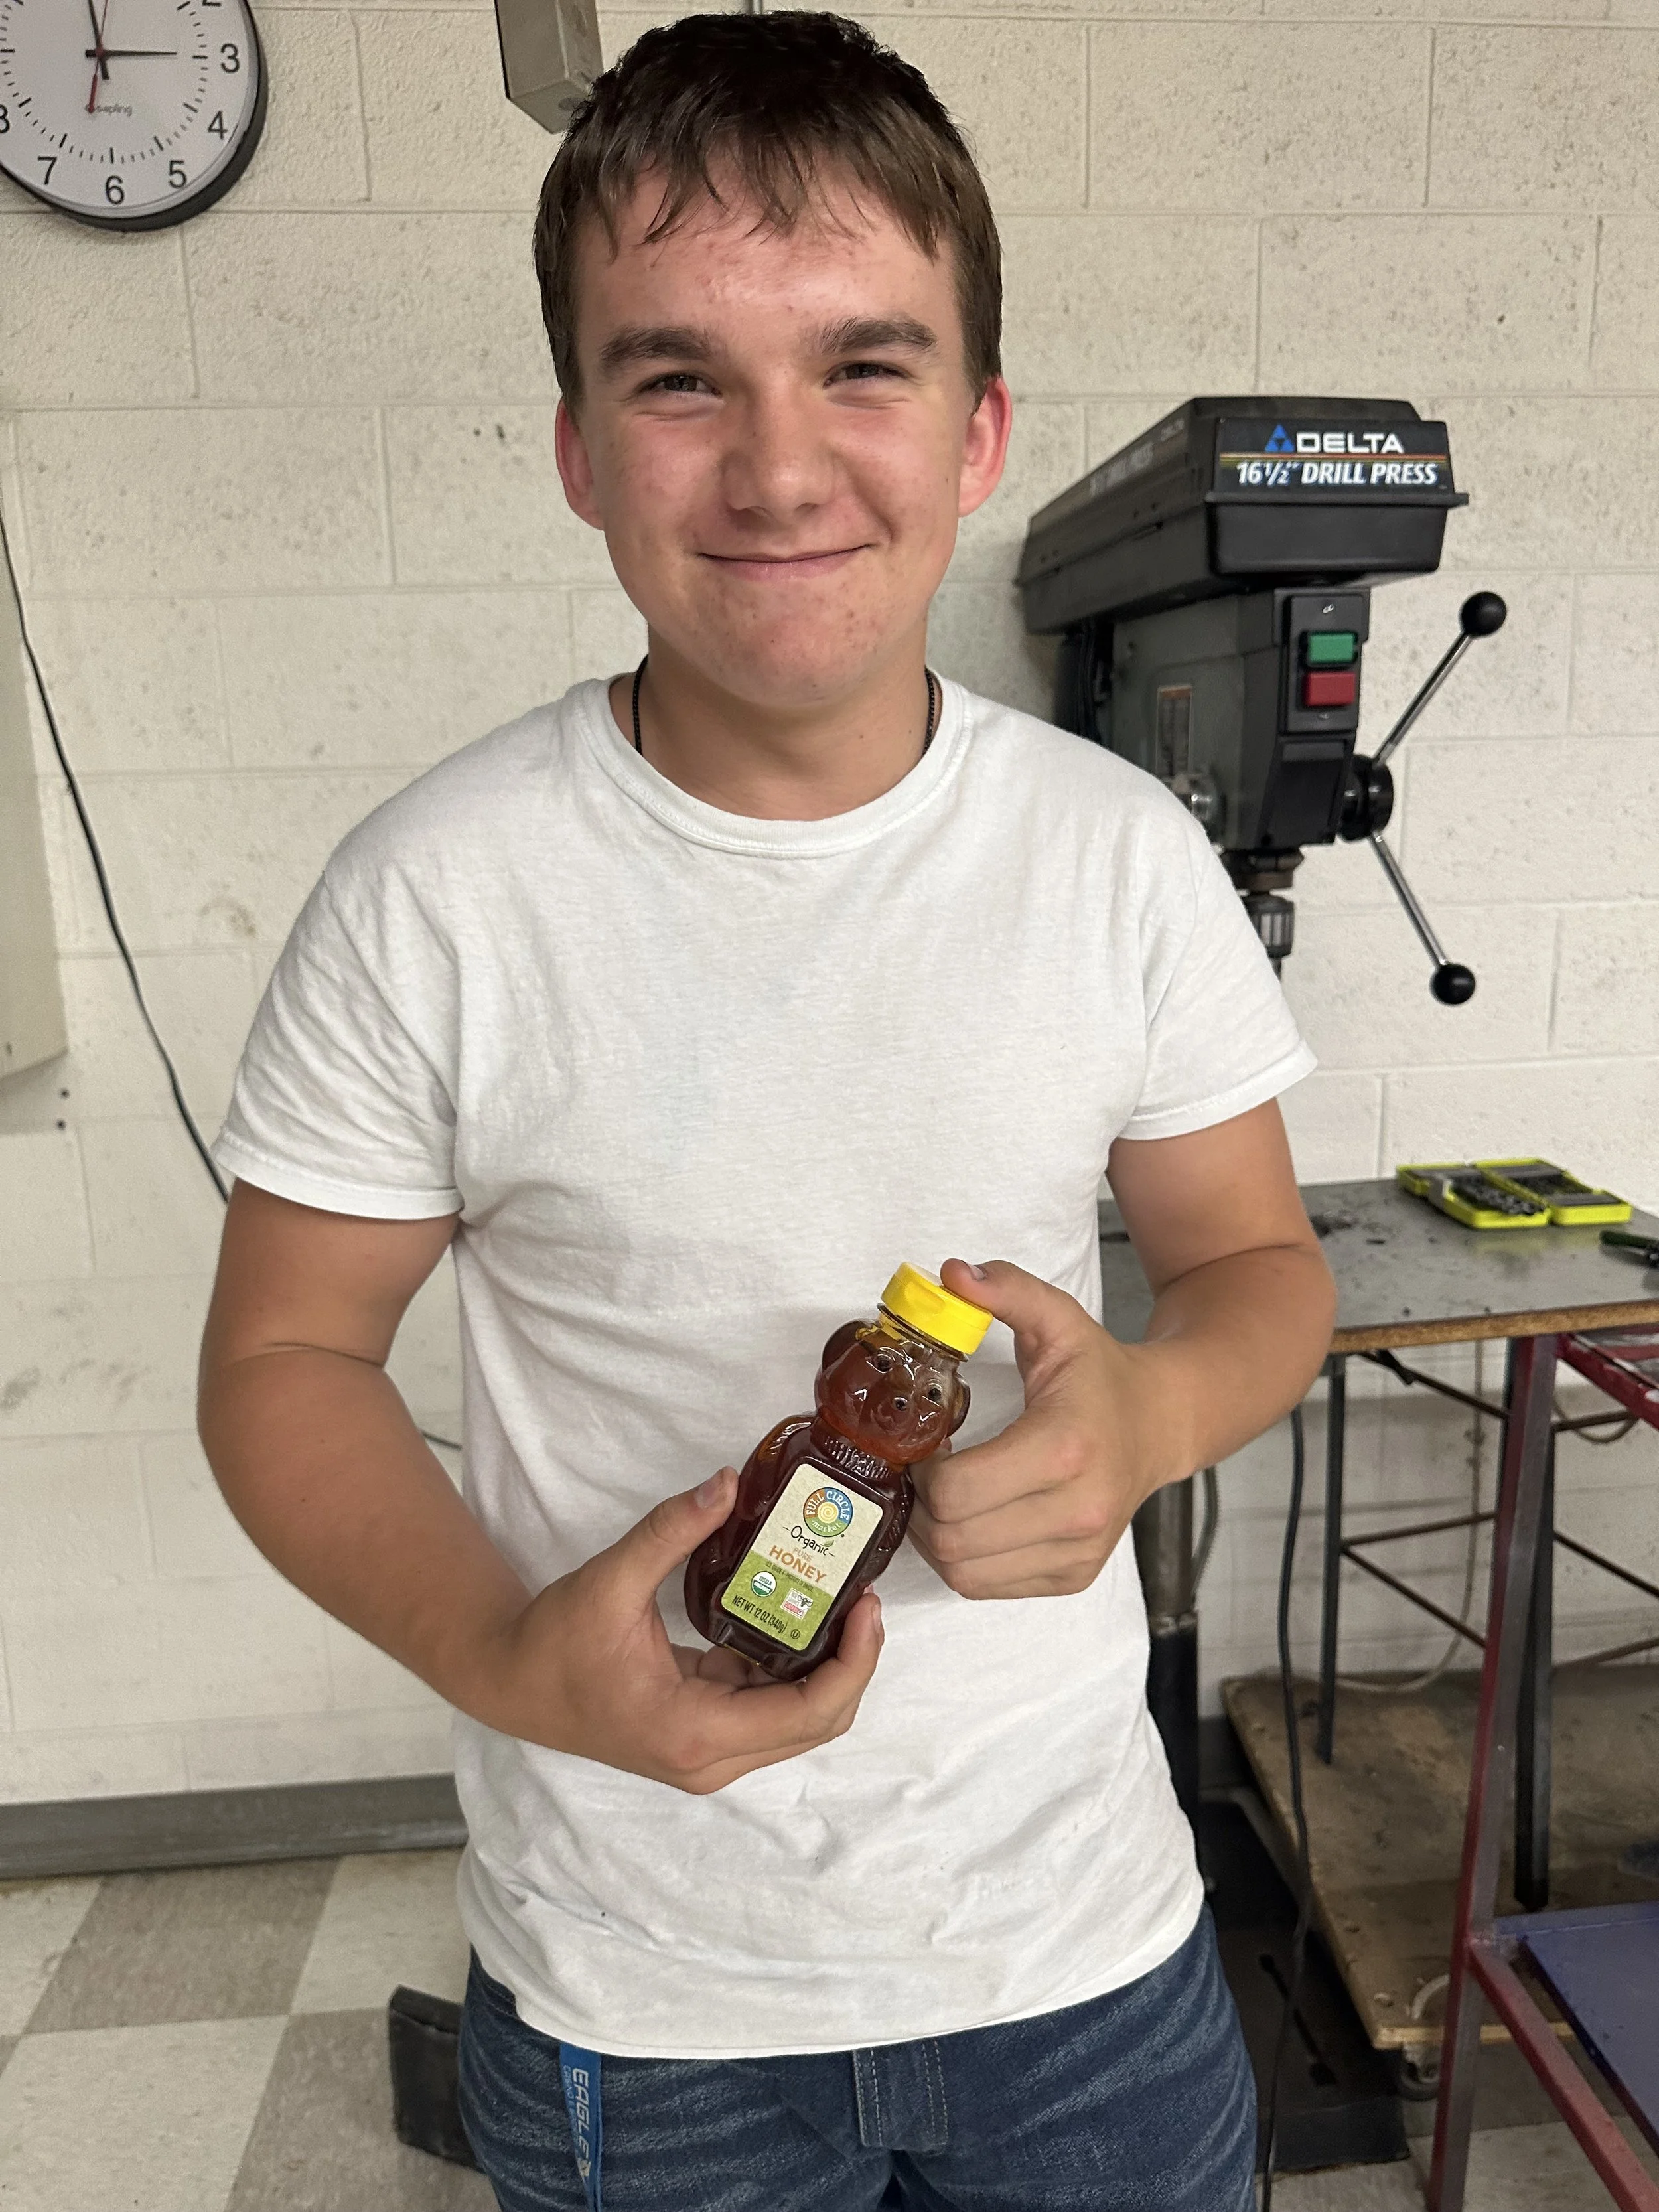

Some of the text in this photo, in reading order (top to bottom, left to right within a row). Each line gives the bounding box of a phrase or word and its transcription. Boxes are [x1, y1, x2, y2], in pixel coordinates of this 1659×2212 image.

[220, 43, 240, 73] 3
[208, 111, 228, 140] 4
[38, 156, 58, 184] 7
[169, 160, 188, 188] 5
[105, 175, 125, 204] 6
[1296, 431, 1405, 454] DELTA
[1301, 463, 1366, 485] DRILL
[1370, 463, 1439, 486] PRESS
[806, 1490, 850, 1520] FULL CIRCLE
[791, 1526, 829, 1556] Organic
[812, 1521, 841, 1532] market
[768, 1545, 827, 1583] HONEY
[793, 1547, 813, 1562] PURE
[759, 1576, 772, 1586] USDA
[732, 1595, 788, 1633] NET WT 12 OZ (340g)
[573, 2067, 589, 2161] EAGLE
